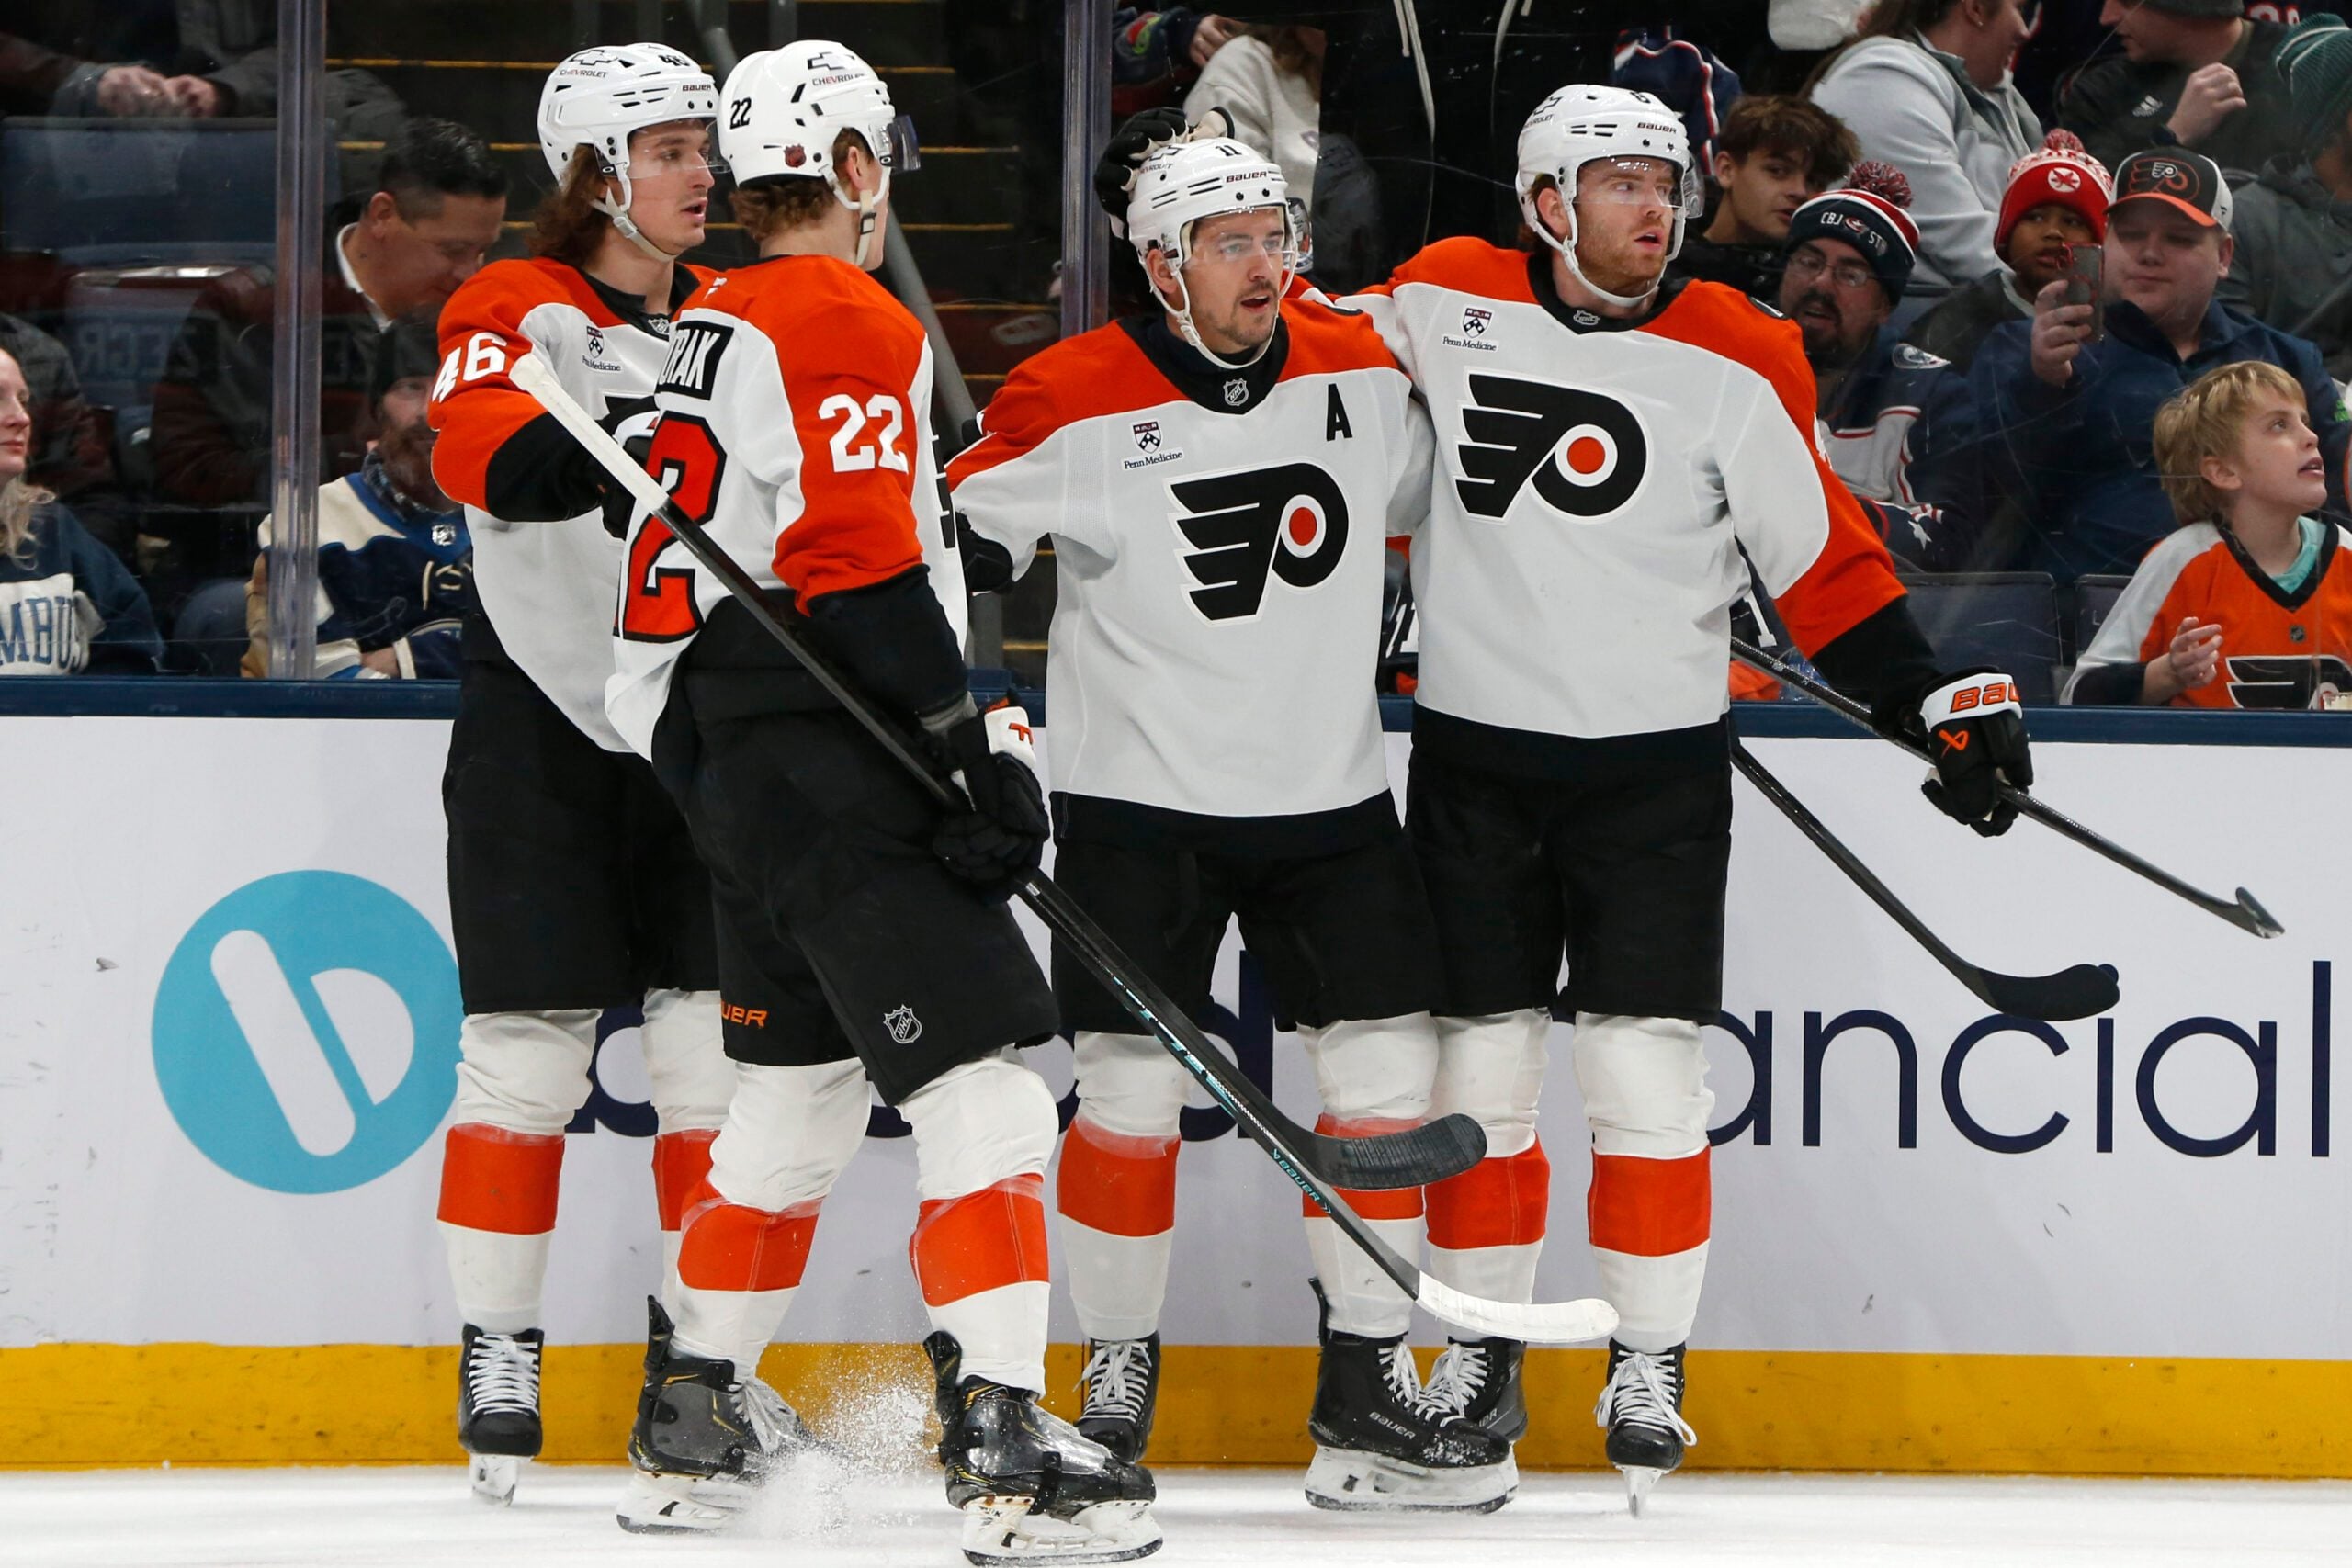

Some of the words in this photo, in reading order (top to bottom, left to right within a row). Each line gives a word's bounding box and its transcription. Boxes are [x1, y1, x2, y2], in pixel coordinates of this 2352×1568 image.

[729, 96, 752, 130] 22
[1216, 144, 1242, 157] 11
[1820, 211, 1844, 225] CBJ
[1442, 336, 1462, 346] Penn
[1462, 340, 1497, 351] Medicine
[432, 331, 507, 404] 46
[1326, 383, 1353, 442] A
[818, 393, 910, 476] 22
[1124, 458, 1145, 470] Penn
[1145, 451, 1183, 465] Medicine
[1706, 960, 2332, 1158] ancial
